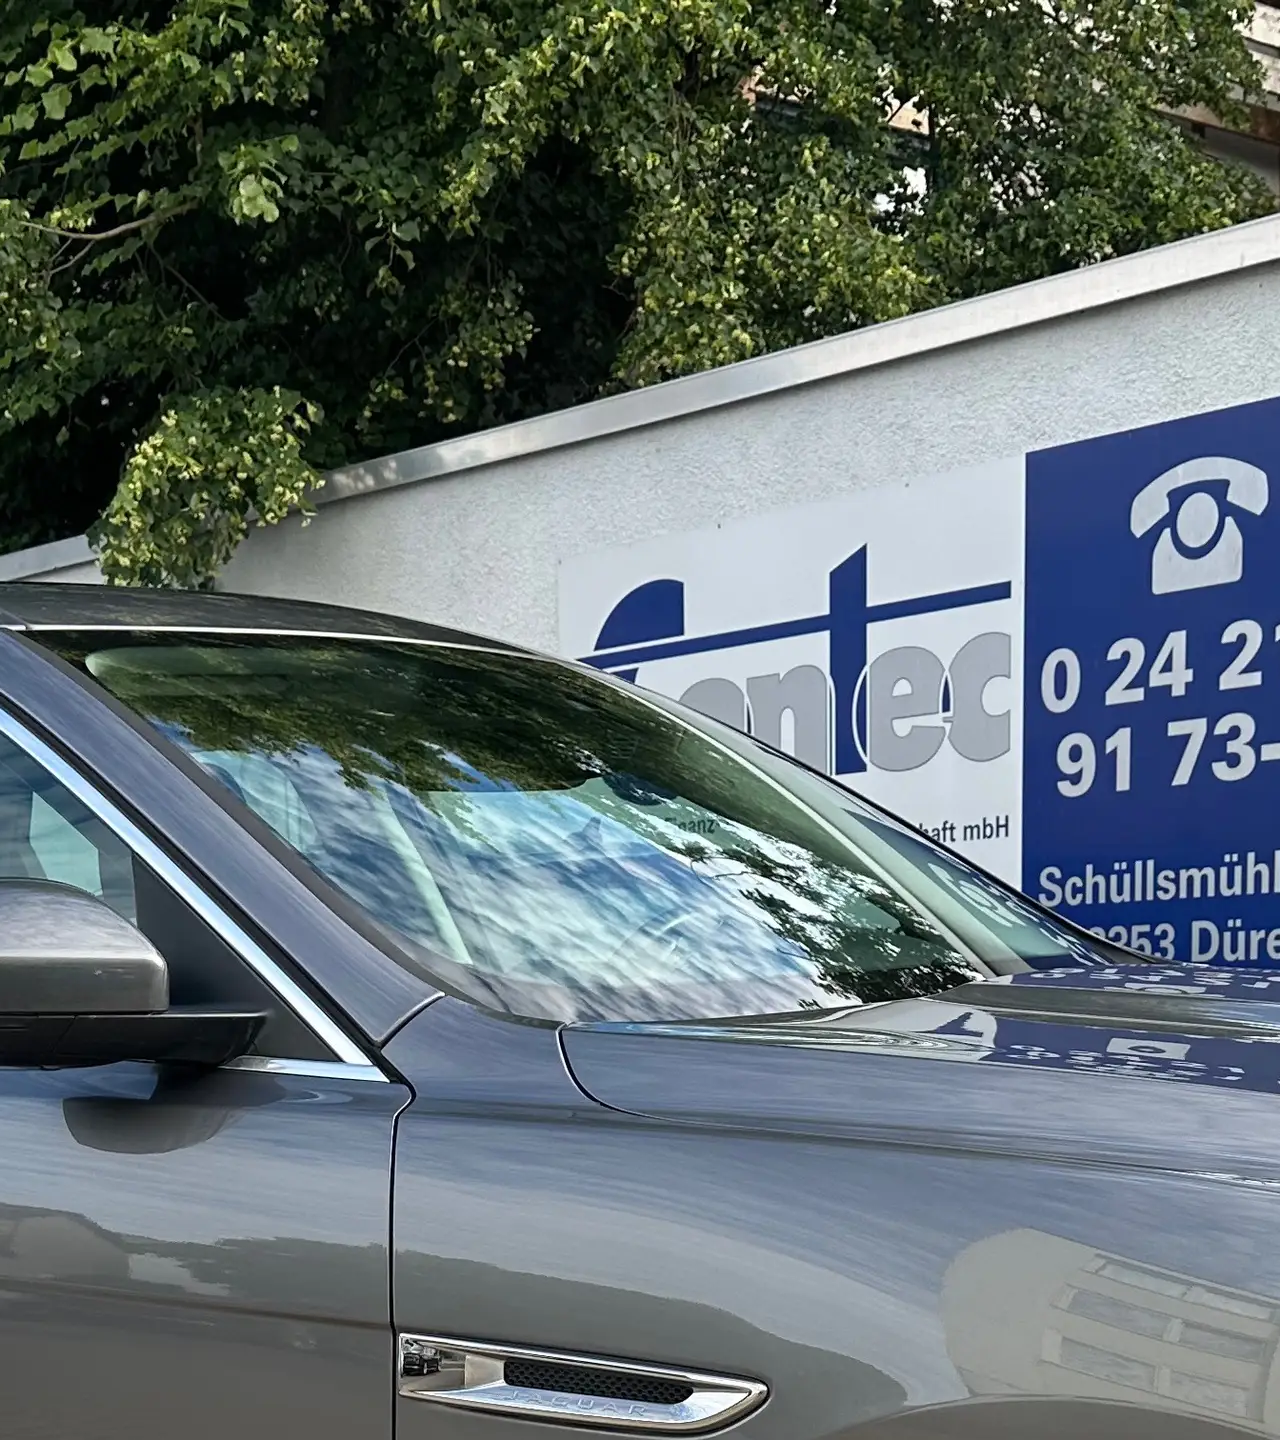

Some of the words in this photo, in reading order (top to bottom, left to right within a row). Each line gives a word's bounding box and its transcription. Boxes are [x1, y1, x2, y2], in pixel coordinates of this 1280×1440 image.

[1041, 647, 1081, 714] 0
[1105, 629, 1194, 706] 24
[1056, 727, 1132, 798] 91
[963, 815, 1010, 841] mbH
[503, 1388, 647, 1417] JAGUAR
